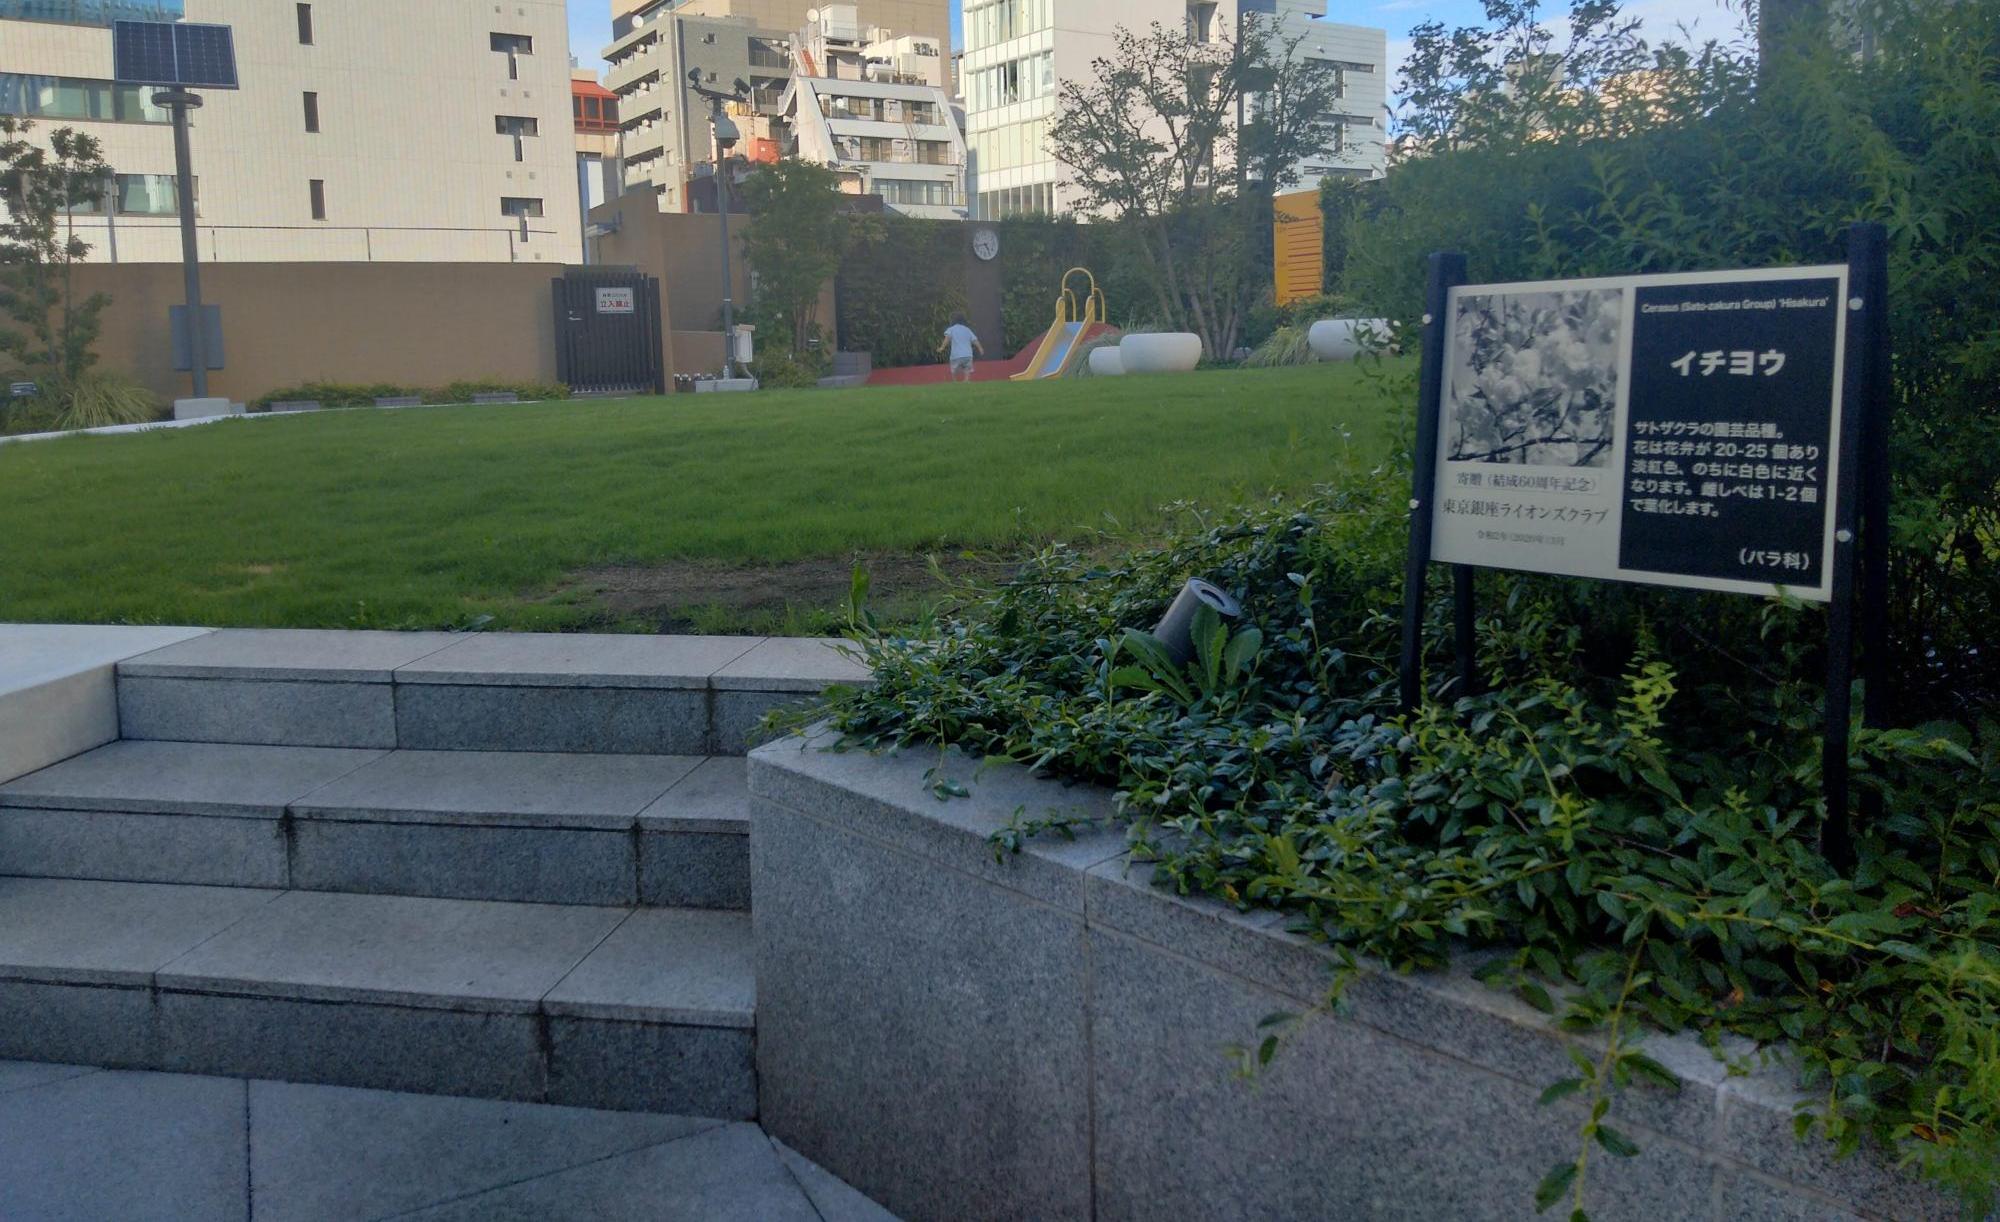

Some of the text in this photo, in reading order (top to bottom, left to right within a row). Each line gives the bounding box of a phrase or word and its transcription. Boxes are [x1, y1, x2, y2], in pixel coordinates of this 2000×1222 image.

[1742, 299, 1776, 310] Group)
[1670, 349, 1786, 376] イチヨウ
[1633, 421, 1784, 439] サトザクラの園芸品種。
[1443, 498, 1609, 525] 東京銀座ライオンズクラブ
[1738, 547, 1810, 570] （バラ科）
